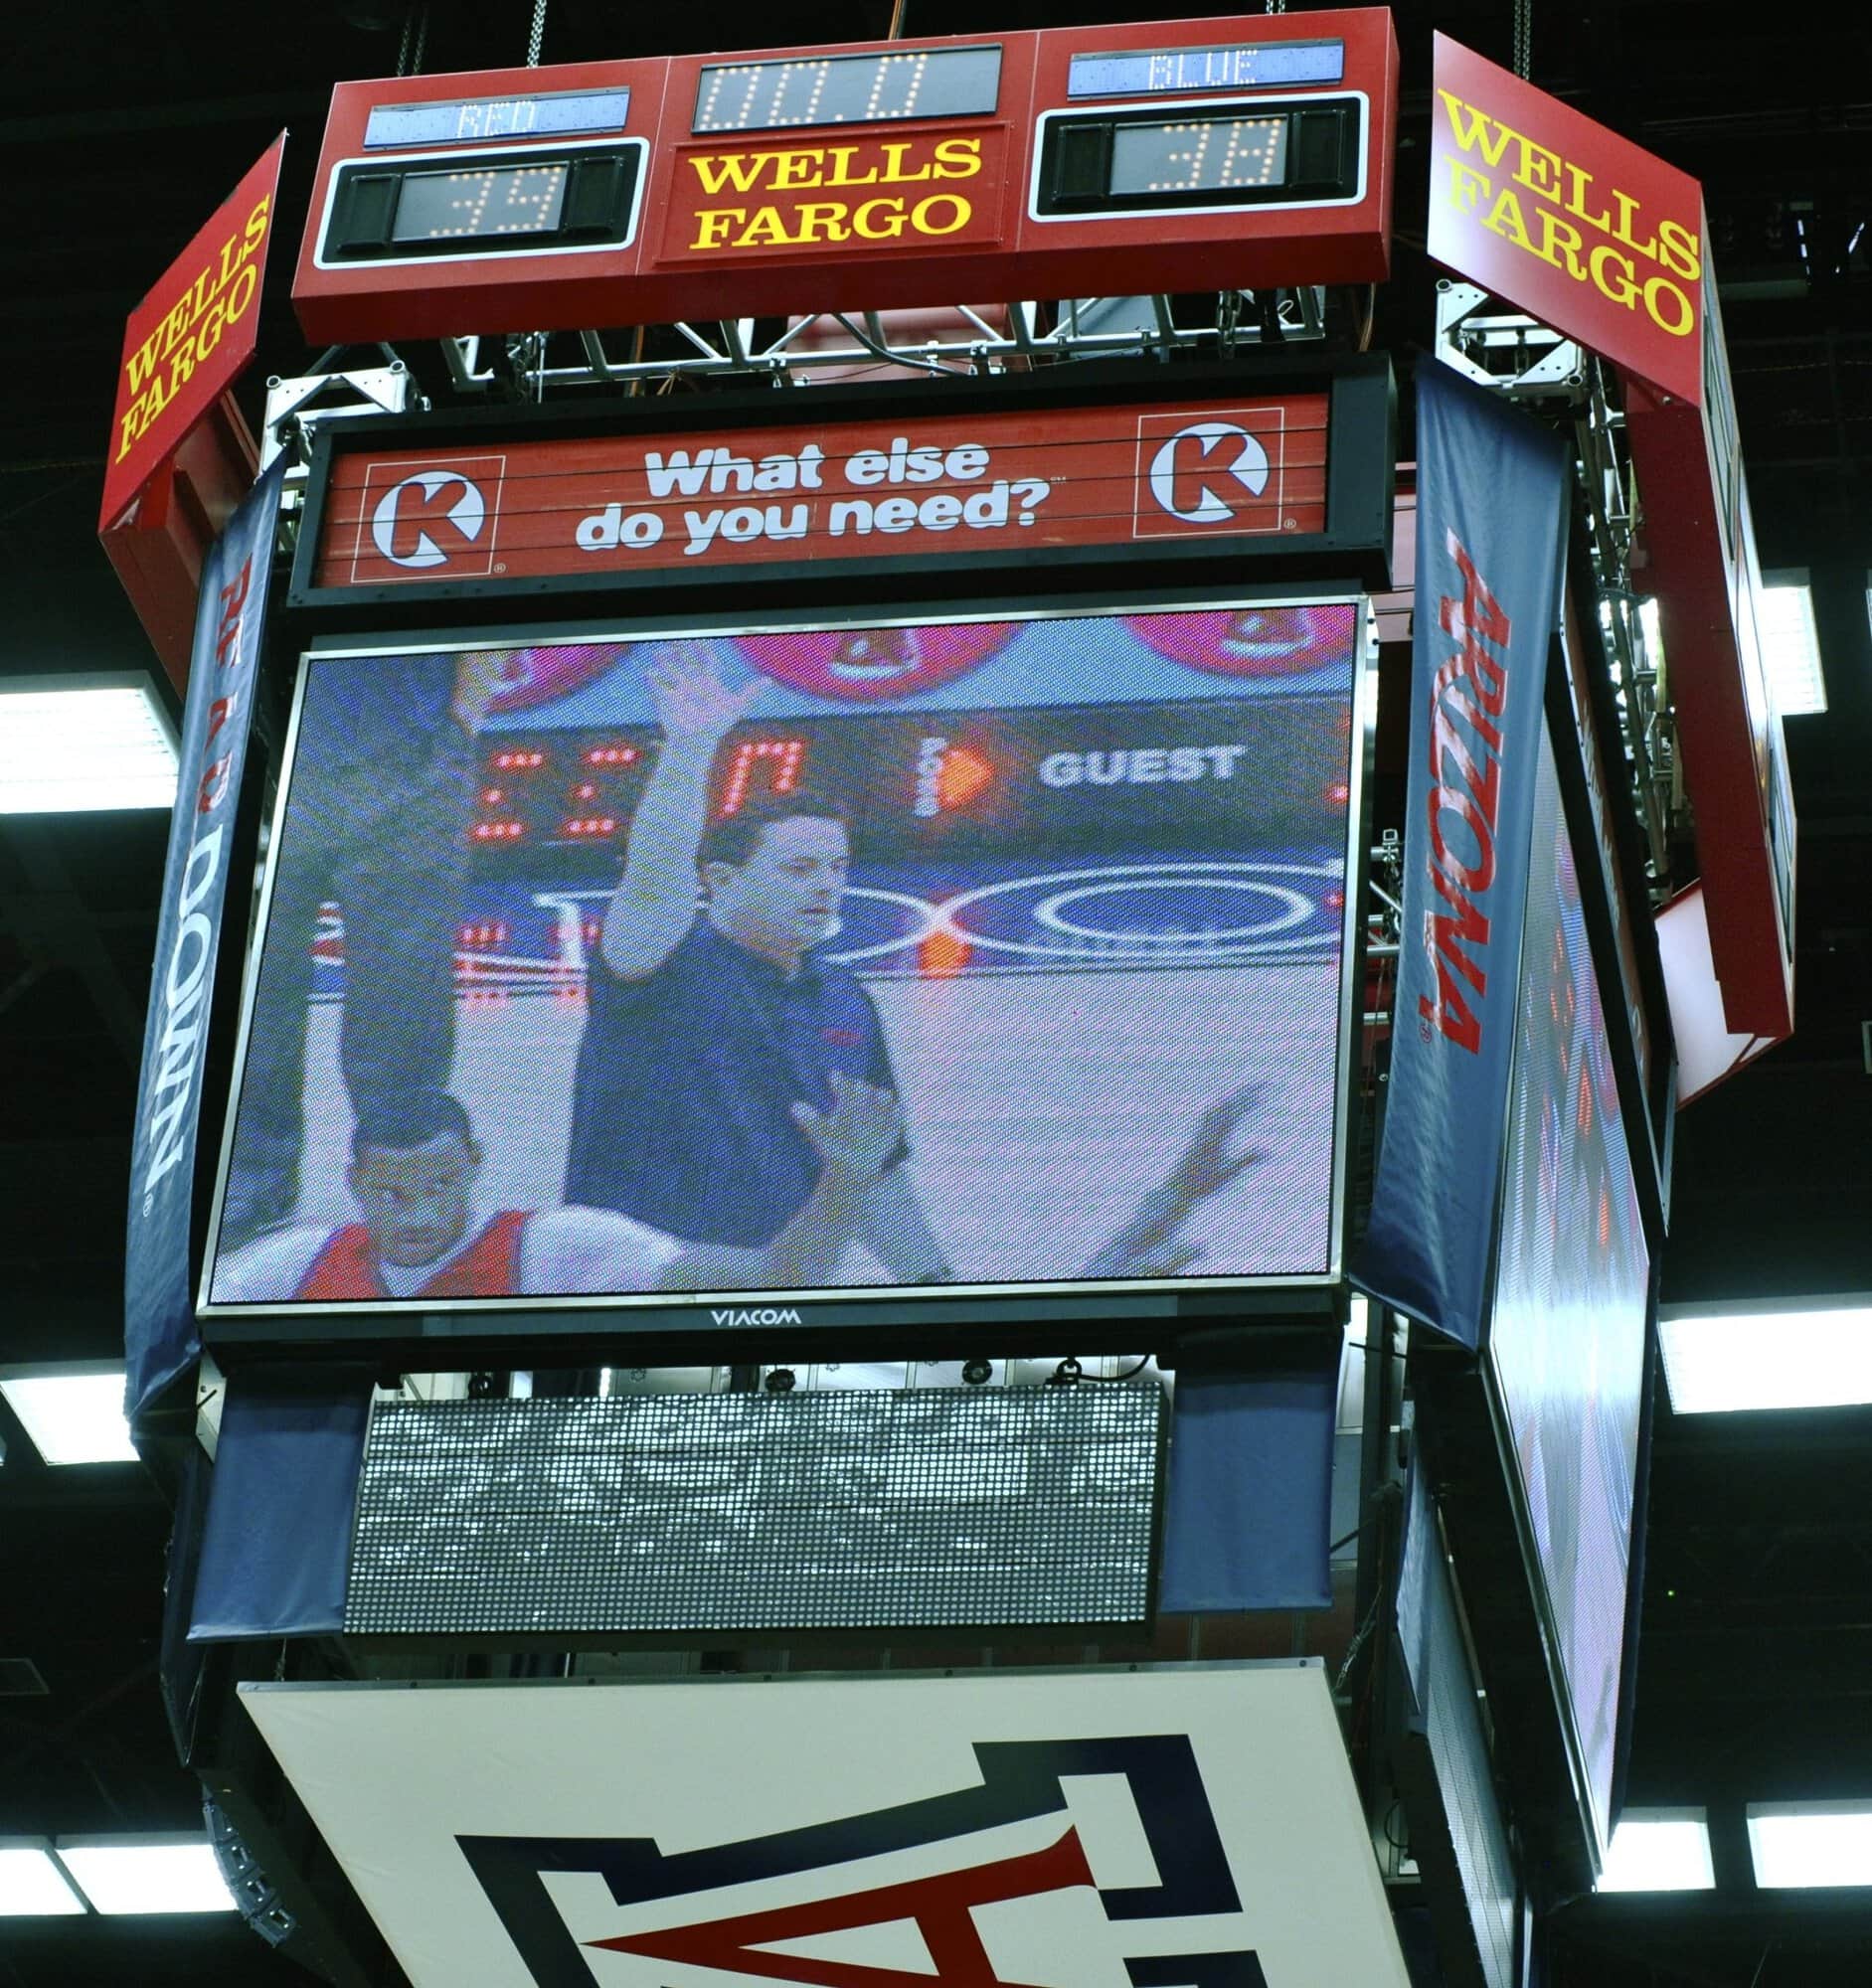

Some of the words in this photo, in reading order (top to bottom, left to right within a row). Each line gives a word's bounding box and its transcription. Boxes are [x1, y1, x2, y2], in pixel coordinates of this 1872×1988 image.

[1149, 50, 1258, 90] BLUE
[458, 100, 536, 138] RED
[1149, 117, 1282, 191] 38
[688, 138, 982, 195] WELLS
[1438, 88, 1701, 281] WELLS
[689, 194, 972, 249] FARGO
[1444, 154, 1694, 336] FARGO
[126, 194, 270, 396] WELLS
[115, 263, 256, 464] FARGO
[645, 444, 825, 497] What
[845, 437, 990, 485] else
[576, 503, 664, 551] do
[684, 503, 809, 556] you
[829, 478, 1051, 536] need?
[1039, 746, 1247, 788] GUEST
[1419, 526, 1512, 1056] ARIZONA
[145, 823, 224, 1194] DOWN
[710, 1308, 802, 1327] VIACOM
